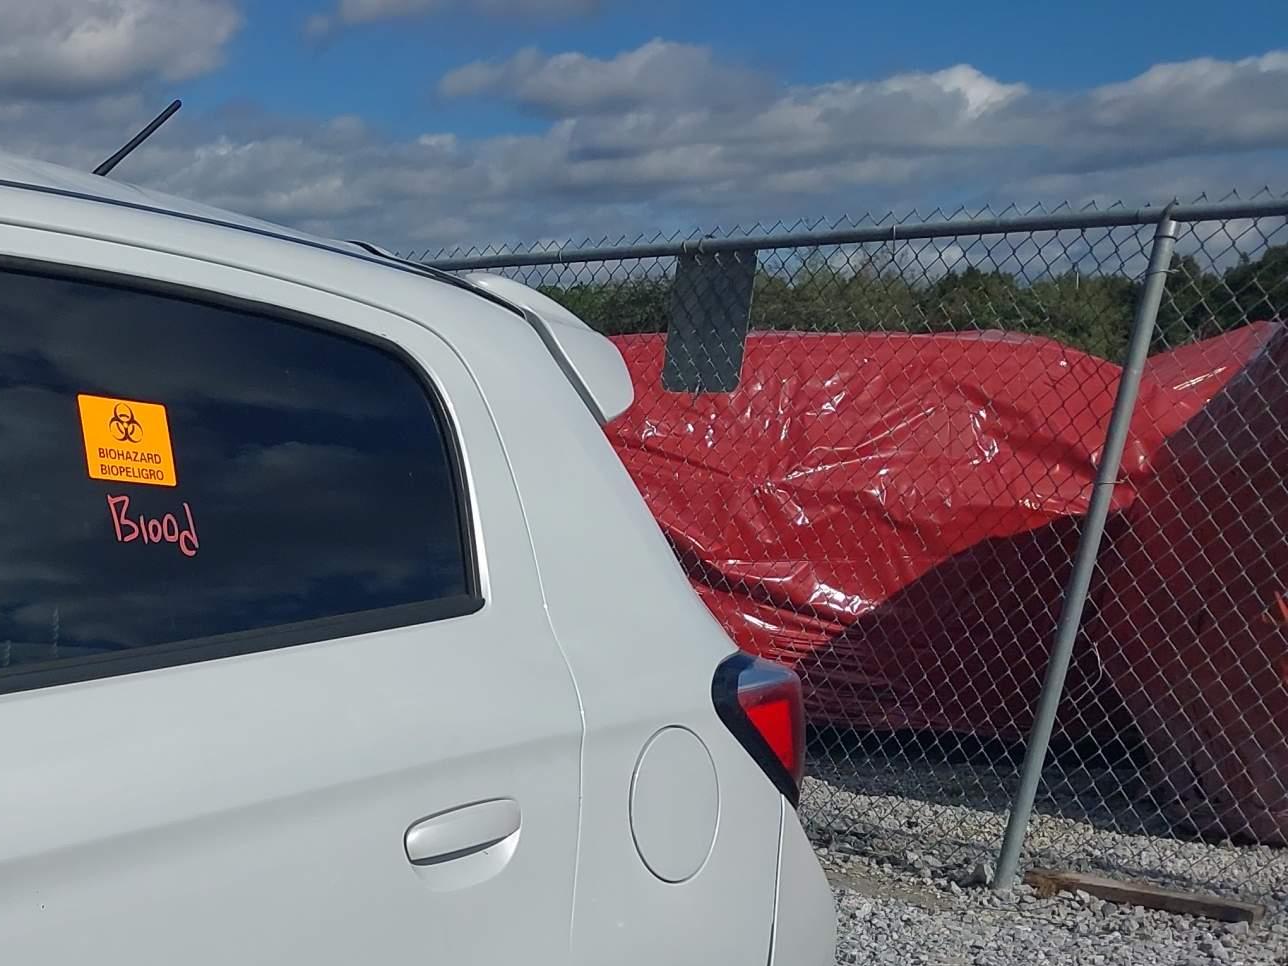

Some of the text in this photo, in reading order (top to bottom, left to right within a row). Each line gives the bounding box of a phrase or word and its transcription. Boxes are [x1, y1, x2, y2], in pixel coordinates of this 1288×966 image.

[98, 447, 162, 465] BIOHAZARD
[100, 463, 165, 481] BIOPELIGRO
[107, 493, 200, 557] Blood
